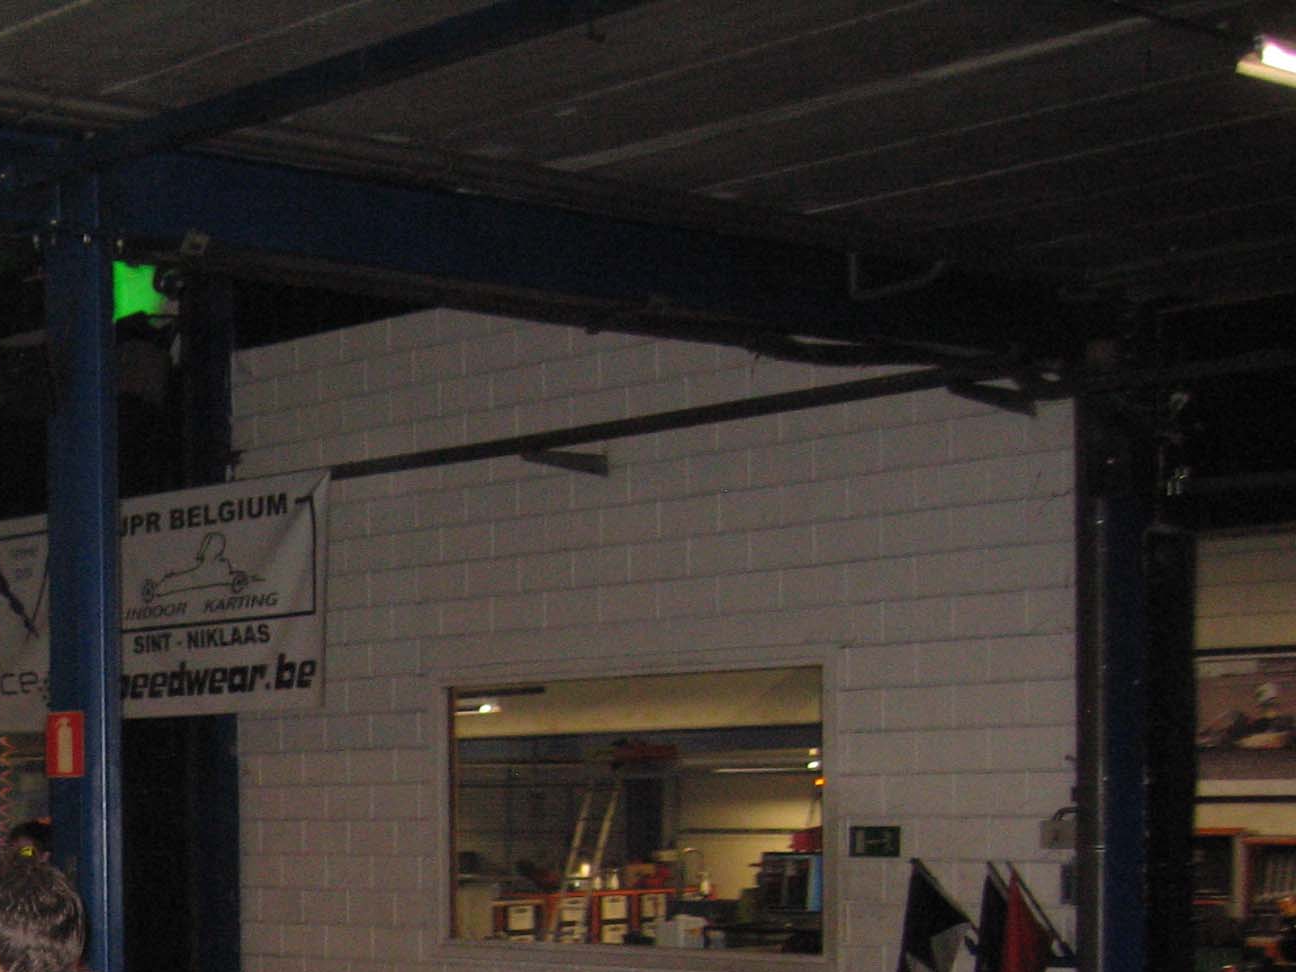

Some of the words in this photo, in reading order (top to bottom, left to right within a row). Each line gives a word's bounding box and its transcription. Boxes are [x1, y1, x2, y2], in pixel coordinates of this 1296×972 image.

[170, 493, 287, 530] BELGIUM
[126, 602, 187, 621] INDOOR
[203, 593, 280, 614] KARTING
[133, 633, 171, 655] SINT
[186, 624, 271, 650] NIKLAAS
